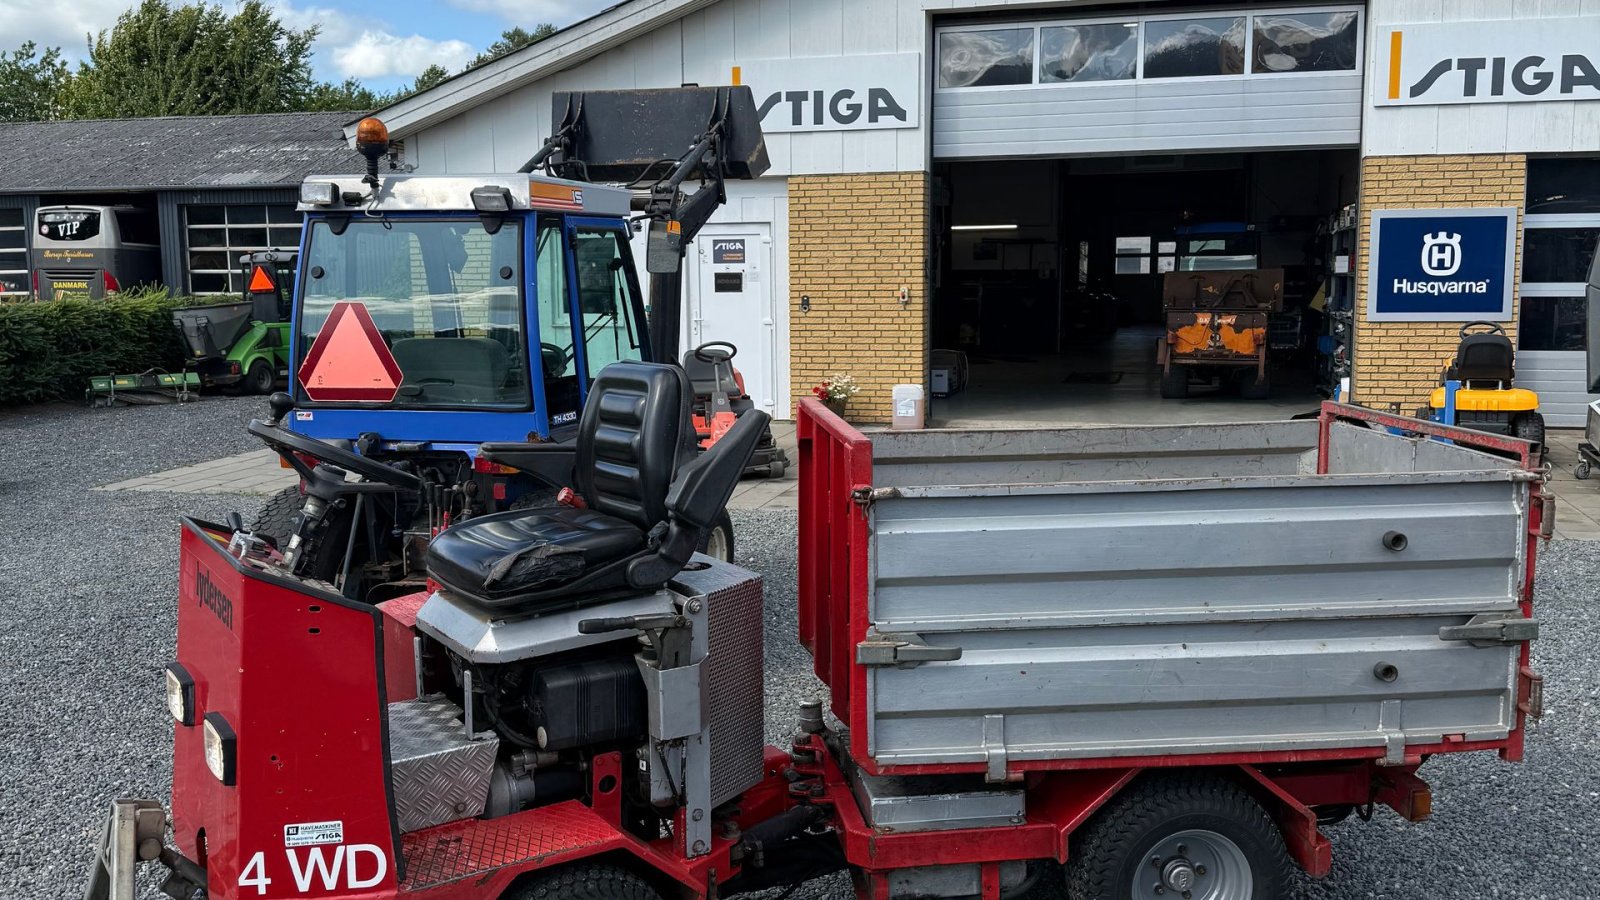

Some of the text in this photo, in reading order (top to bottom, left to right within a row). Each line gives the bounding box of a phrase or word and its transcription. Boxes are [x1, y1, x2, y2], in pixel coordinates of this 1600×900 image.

[1409, 54, 1600, 98] STIGA
[757, 88, 906, 126] STIGA
[57, 221, 80, 237] VIP
[714, 242, 744, 250] STIGA
[1431, 245, 1452, 268] H
[1393, 278, 1490, 296] Husqvarna
[315, 832, 342, 840] STIGA
[238, 844, 387, 895] 4 WD
